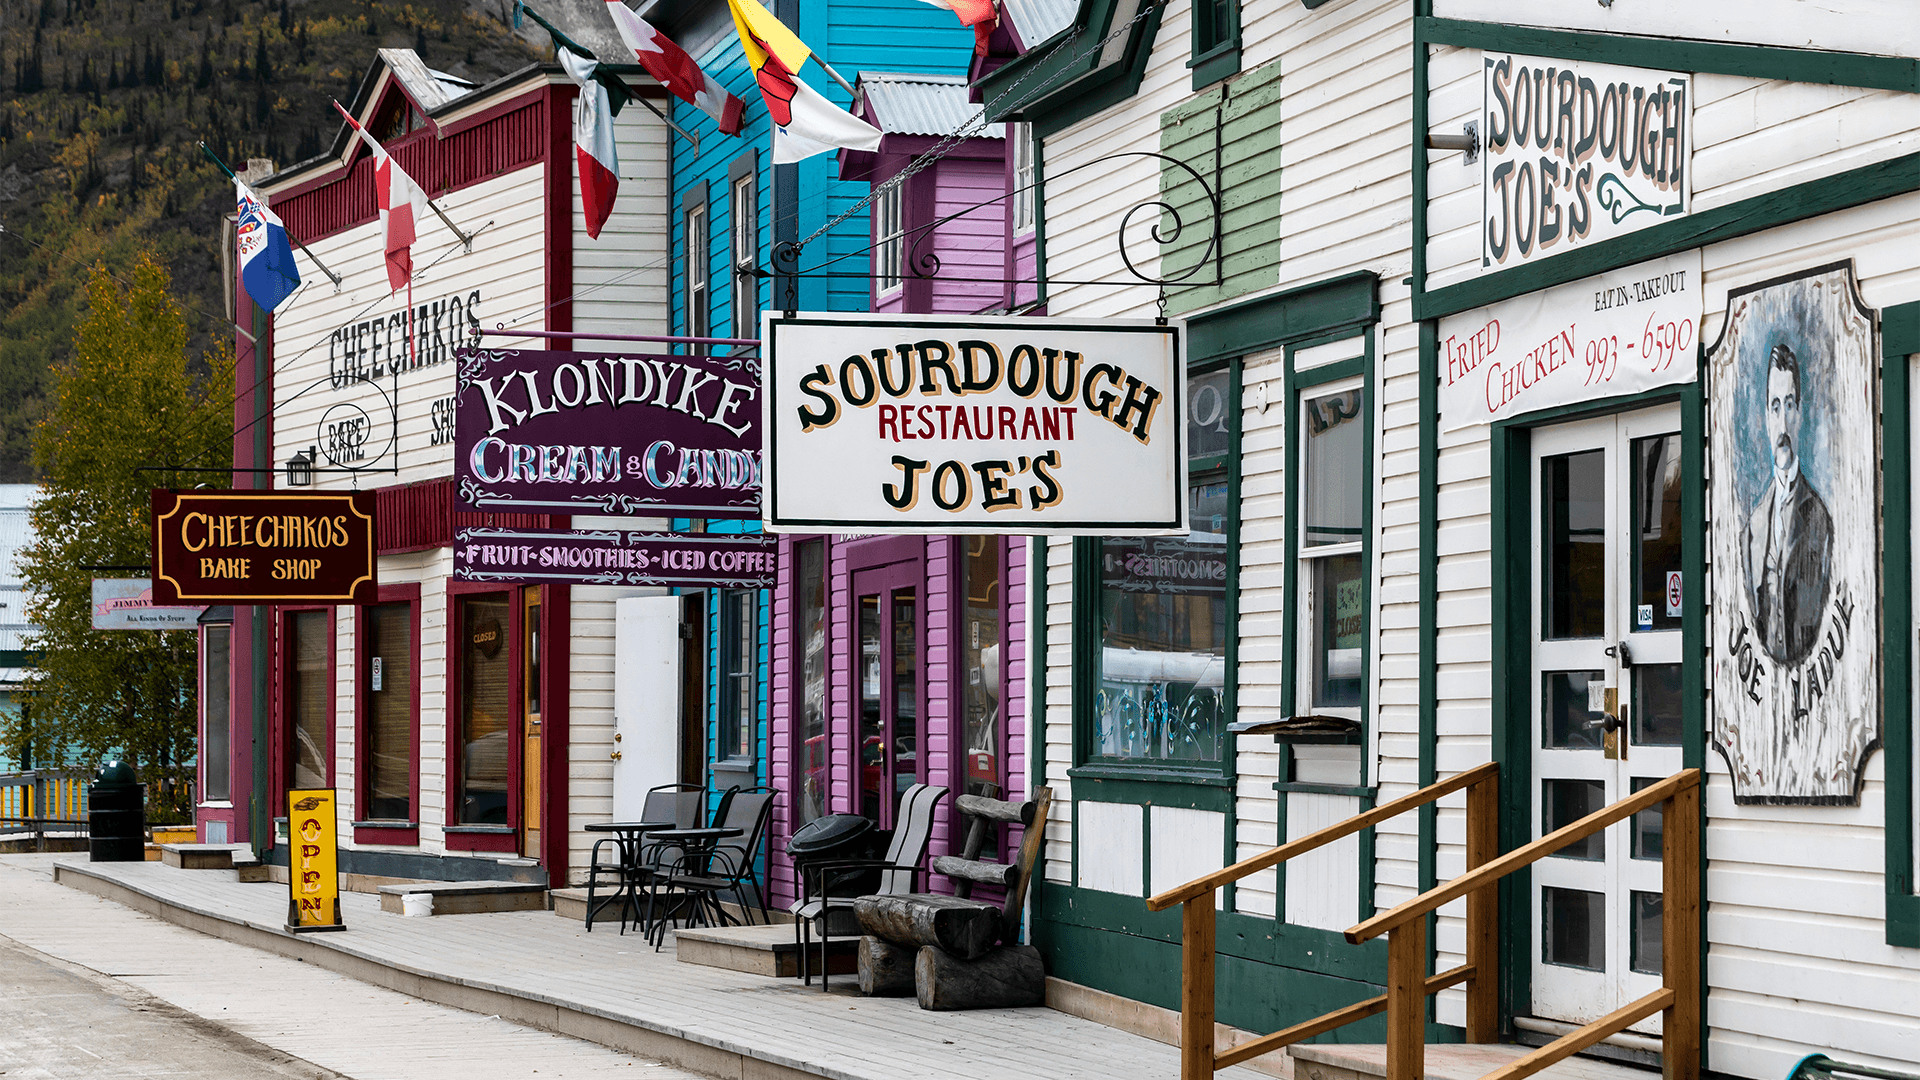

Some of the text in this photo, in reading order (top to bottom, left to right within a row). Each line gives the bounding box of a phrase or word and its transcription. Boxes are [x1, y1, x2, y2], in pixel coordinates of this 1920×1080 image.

[1488, 55, 1682, 192] SOURDOUGH
[1488, 156, 1594, 264] JOE'S
[1594, 288, 1615, 312] EAT
[1616, 285, 1629, 307] IN
[330, 289, 481, 390] CHEECHAKOS
[1446, 319, 1501, 387] FRIED
[1485, 323, 1576, 413] CHICKEN
[471, 357, 756, 438] KLONDYKE
[797, 339, 1162, 446] SOURDOUGH
[878, 404, 1078, 442] RESTAURANT
[328, 417, 365, 465] BAKE
[469, 436, 622, 485] CREAM
[642, 440, 762, 491] CANDY
[881, 450, 1064, 514] JOE'S
[181, 511, 349, 552] CHEECHAKOS
[708, 551, 776, 573] COFFEE
[200, 557, 322, 580] BAKE SHOP
[473, 630, 497, 644] CLOSED
[1638, 609, 1652, 621] VISA
[1729, 611, 1766, 706] JOE
[299, 818, 322, 923] OPEN
